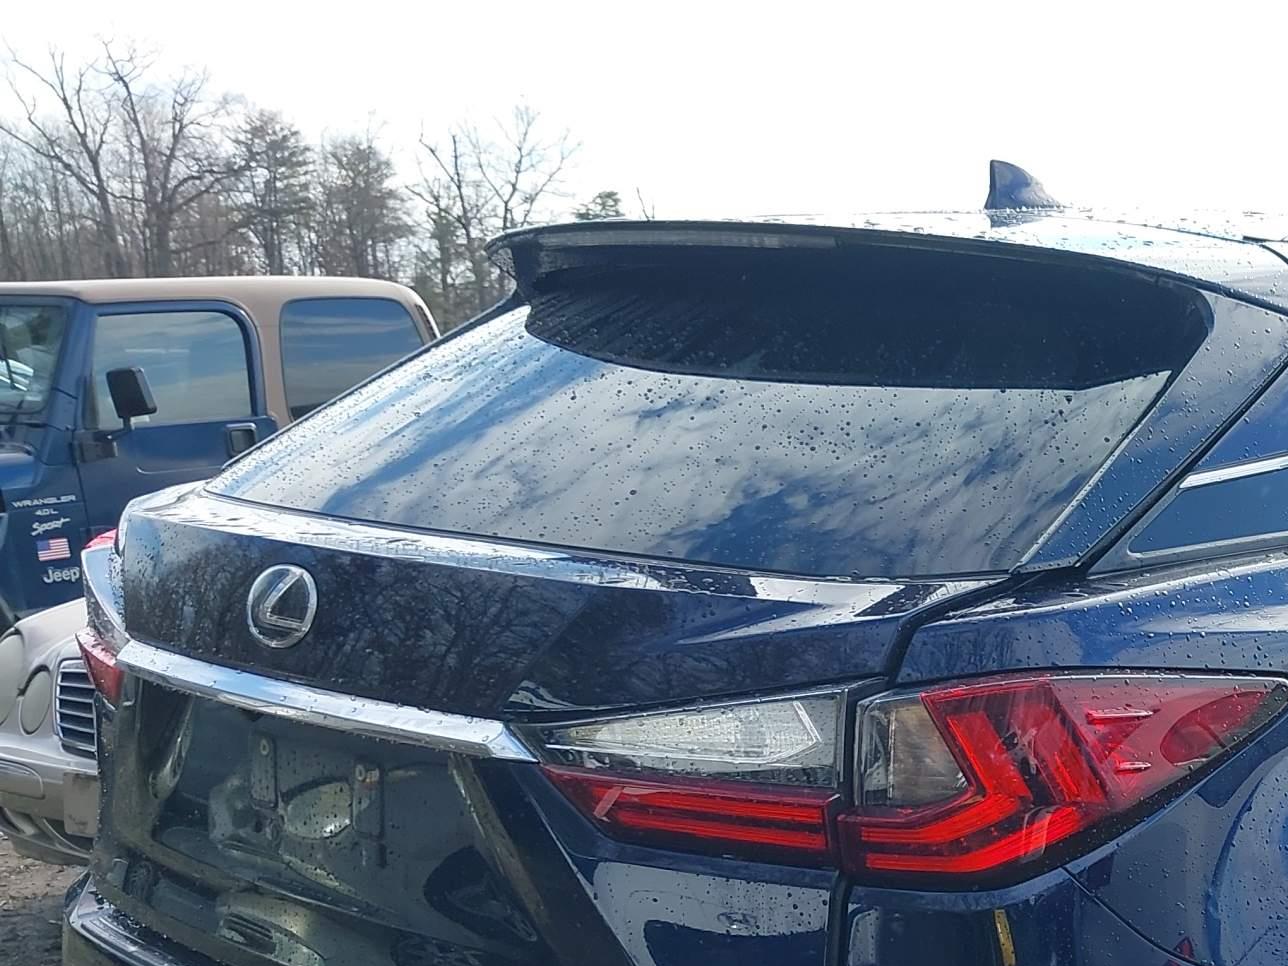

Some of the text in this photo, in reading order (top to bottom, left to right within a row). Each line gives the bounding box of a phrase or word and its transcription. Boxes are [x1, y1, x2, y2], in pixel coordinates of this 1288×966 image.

[11, 495, 77, 508] WRANGLER
[31, 517, 71, 536] Sport
[43, 566, 81, 583] Jeep
